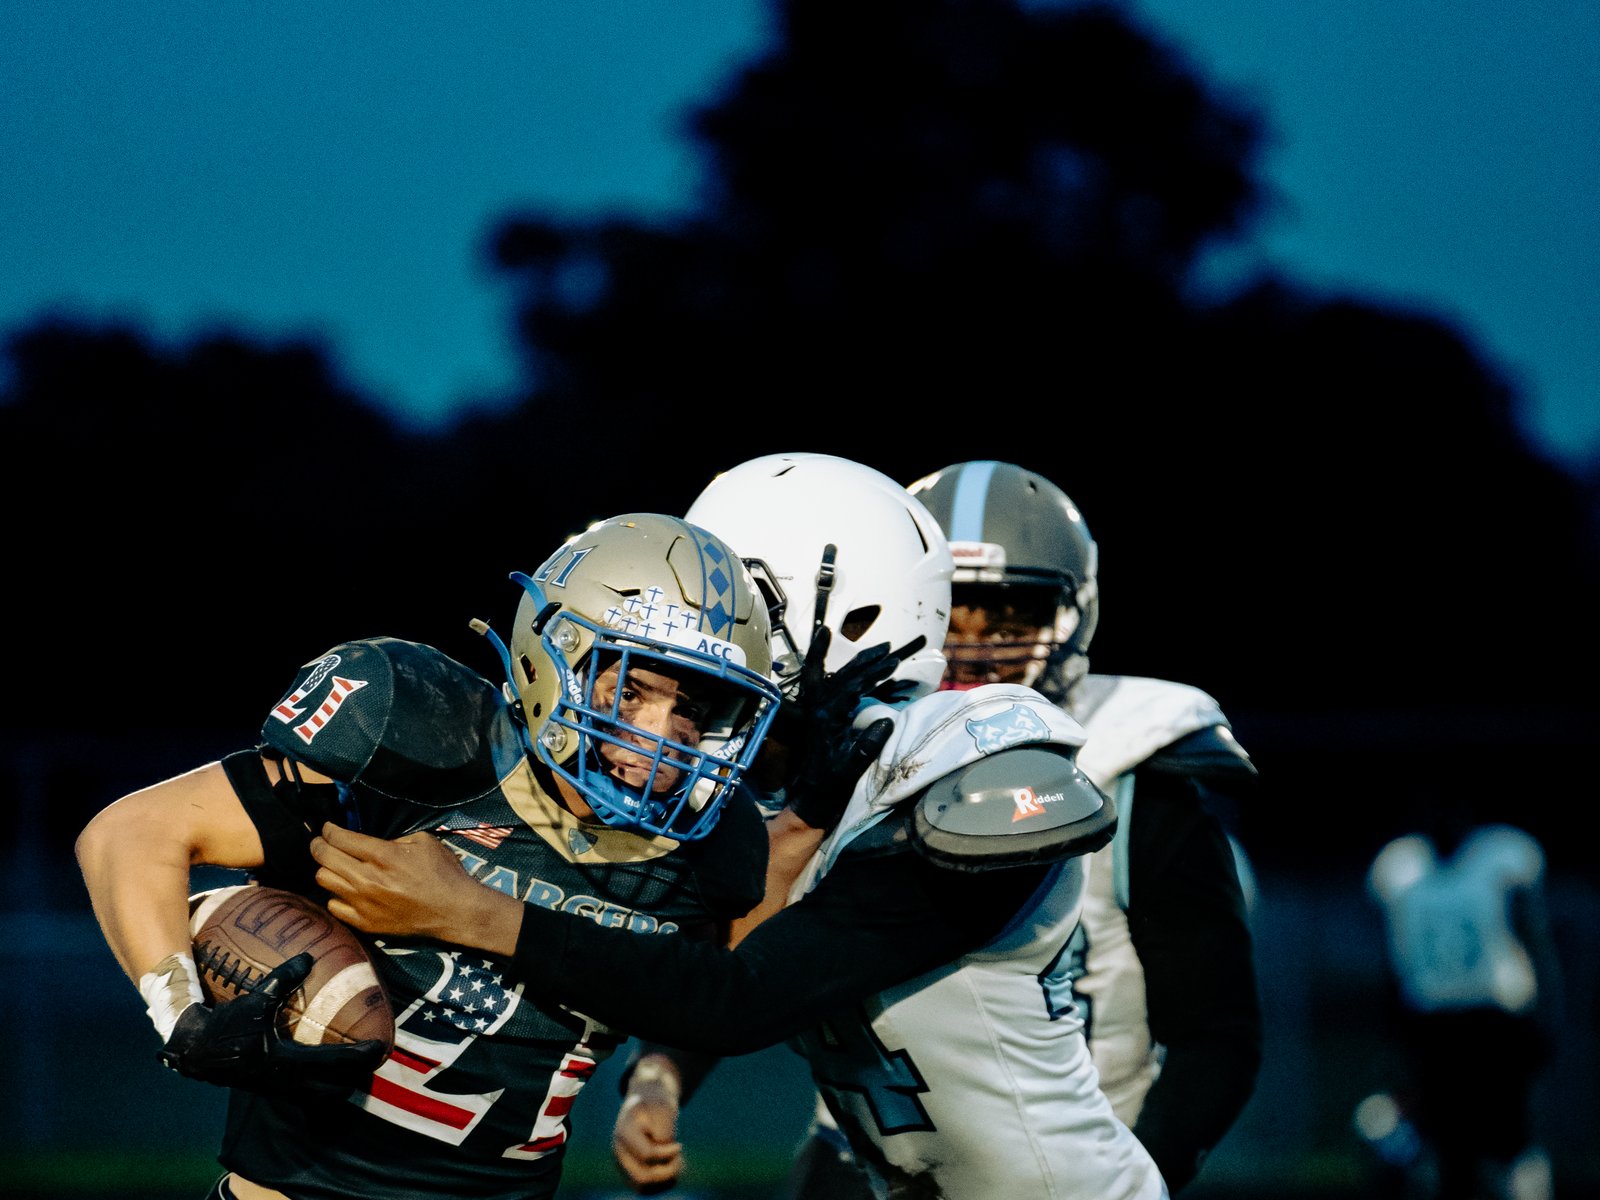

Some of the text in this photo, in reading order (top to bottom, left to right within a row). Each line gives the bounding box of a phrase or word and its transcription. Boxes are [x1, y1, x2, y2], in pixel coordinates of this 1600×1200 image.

[534, 544, 599, 588] 21
[697, 638, 733, 662] ACC
[270, 653, 369, 745] 21
[1013, 788, 1065, 815] Riddell
[354, 940, 612, 1161] 21
